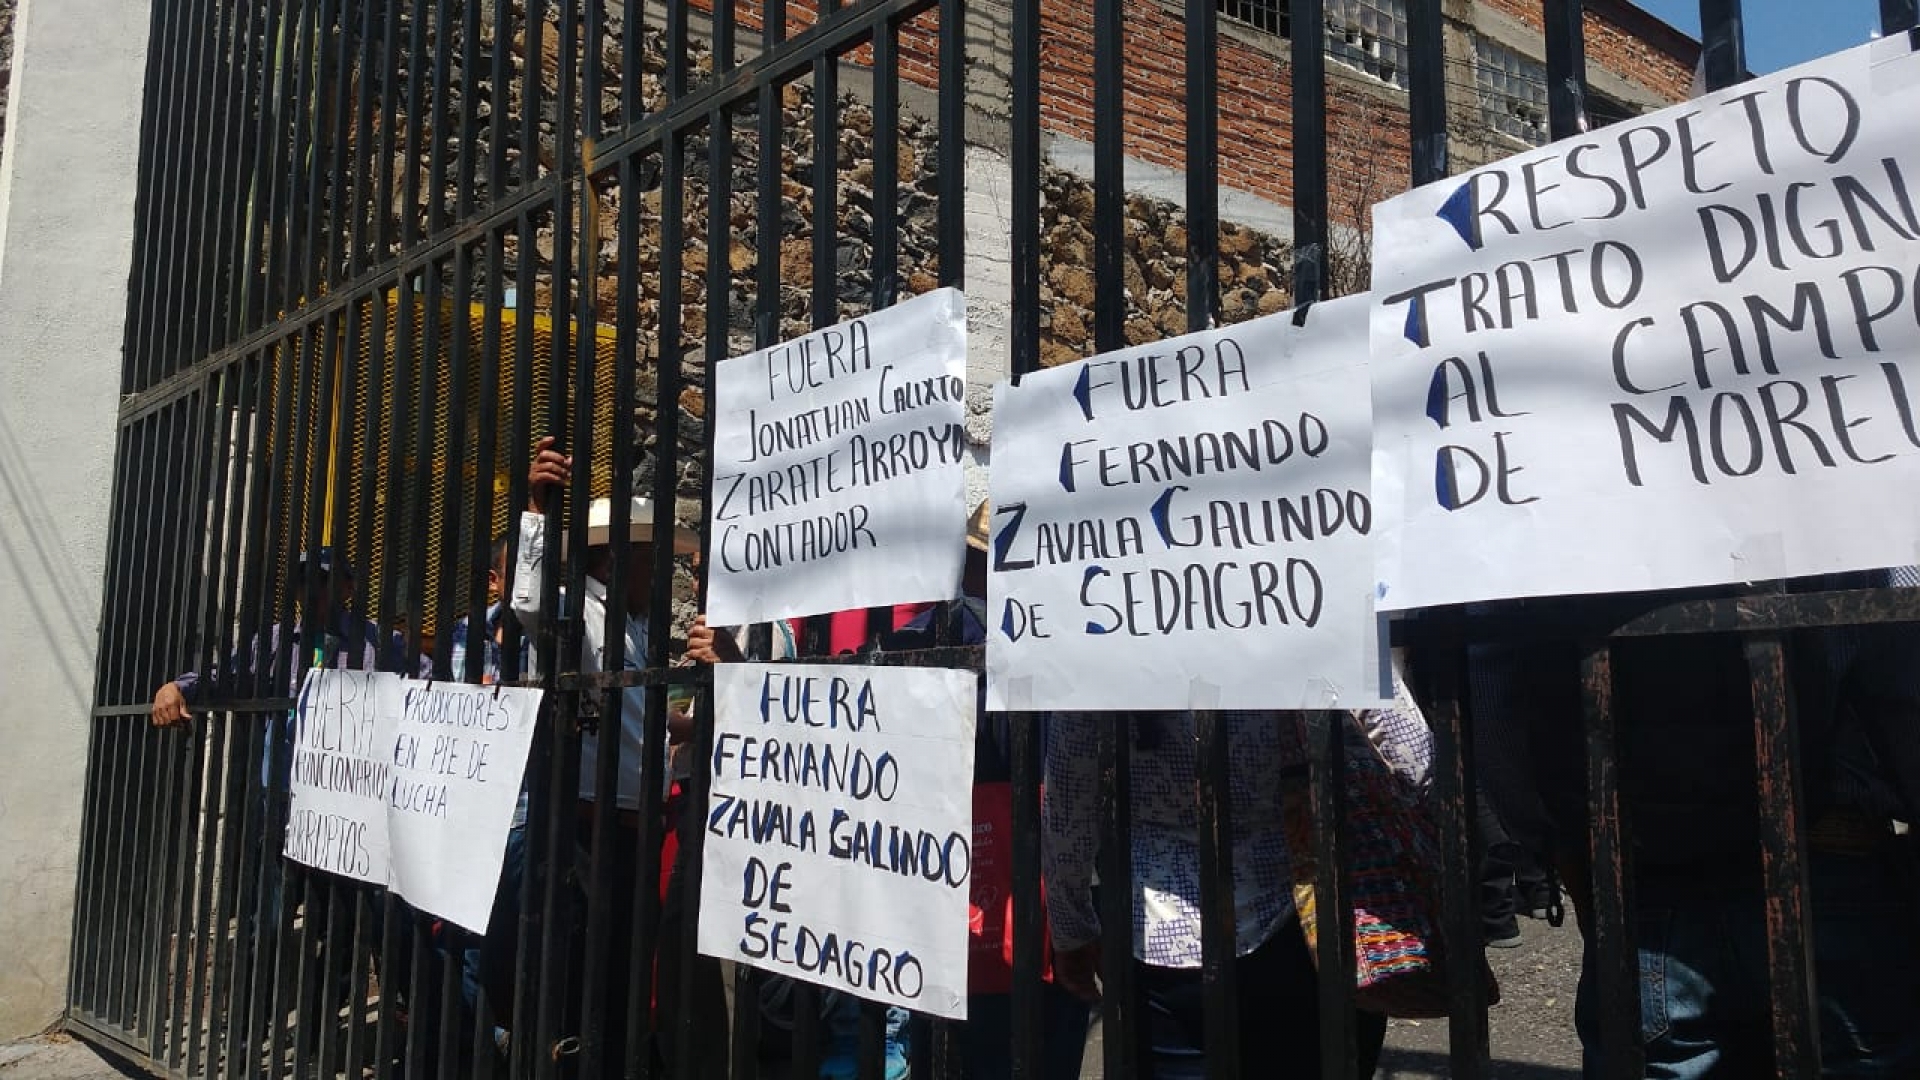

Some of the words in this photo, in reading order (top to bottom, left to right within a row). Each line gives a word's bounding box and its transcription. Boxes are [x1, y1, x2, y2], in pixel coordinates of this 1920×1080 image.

[1436, 76, 1861, 251] RESPETO
[1382, 241, 1643, 348] TRATO
[767, 320, 872, 402] FUERA
[1073, 338, 1249, 422] FUERA
[1426, 351, 1533, 429] AL
[1612, 266, 1920, 394] CAMP
[738, 397, 871, 462] JONATHAN
[879, 365, 964, 415] CALIXTO
[1059, 412, 1329, 492] FERNANDO
[716, 450, 844, 521] ZARATE
[850, 424, 966, 487] ARROYO
[1435, 431, 1540, 512] DE
[721, 504, 877, 574] CONTADOR
[993, 501, 1143, 572] ZAVALA
[1150, 486, 1371, 550] GALINDO
[1001, 597, 1050, 643] DE
[1080, 557, 1323, 638] SEDAGRO
[298, 670, 377, 757] FUERA
[403, 687, 510, 731] PRODUCTORES
[760, 671, 880, 732] FUERA
[392, 776, 447, 819] LUCHA
[393, 734, 420, 770] EN
[430, 735, 459, 774] PIE
[467, 740, 490, 782] DE
[714, 732, 898, 802] FERNANDO
[708, 793, 817, 853] ZAVALA
[828, 809, 970, 889] GALINDO
[742, 856, 792, 913] DE
[740, 911, 923, 999] SEDAGRO
